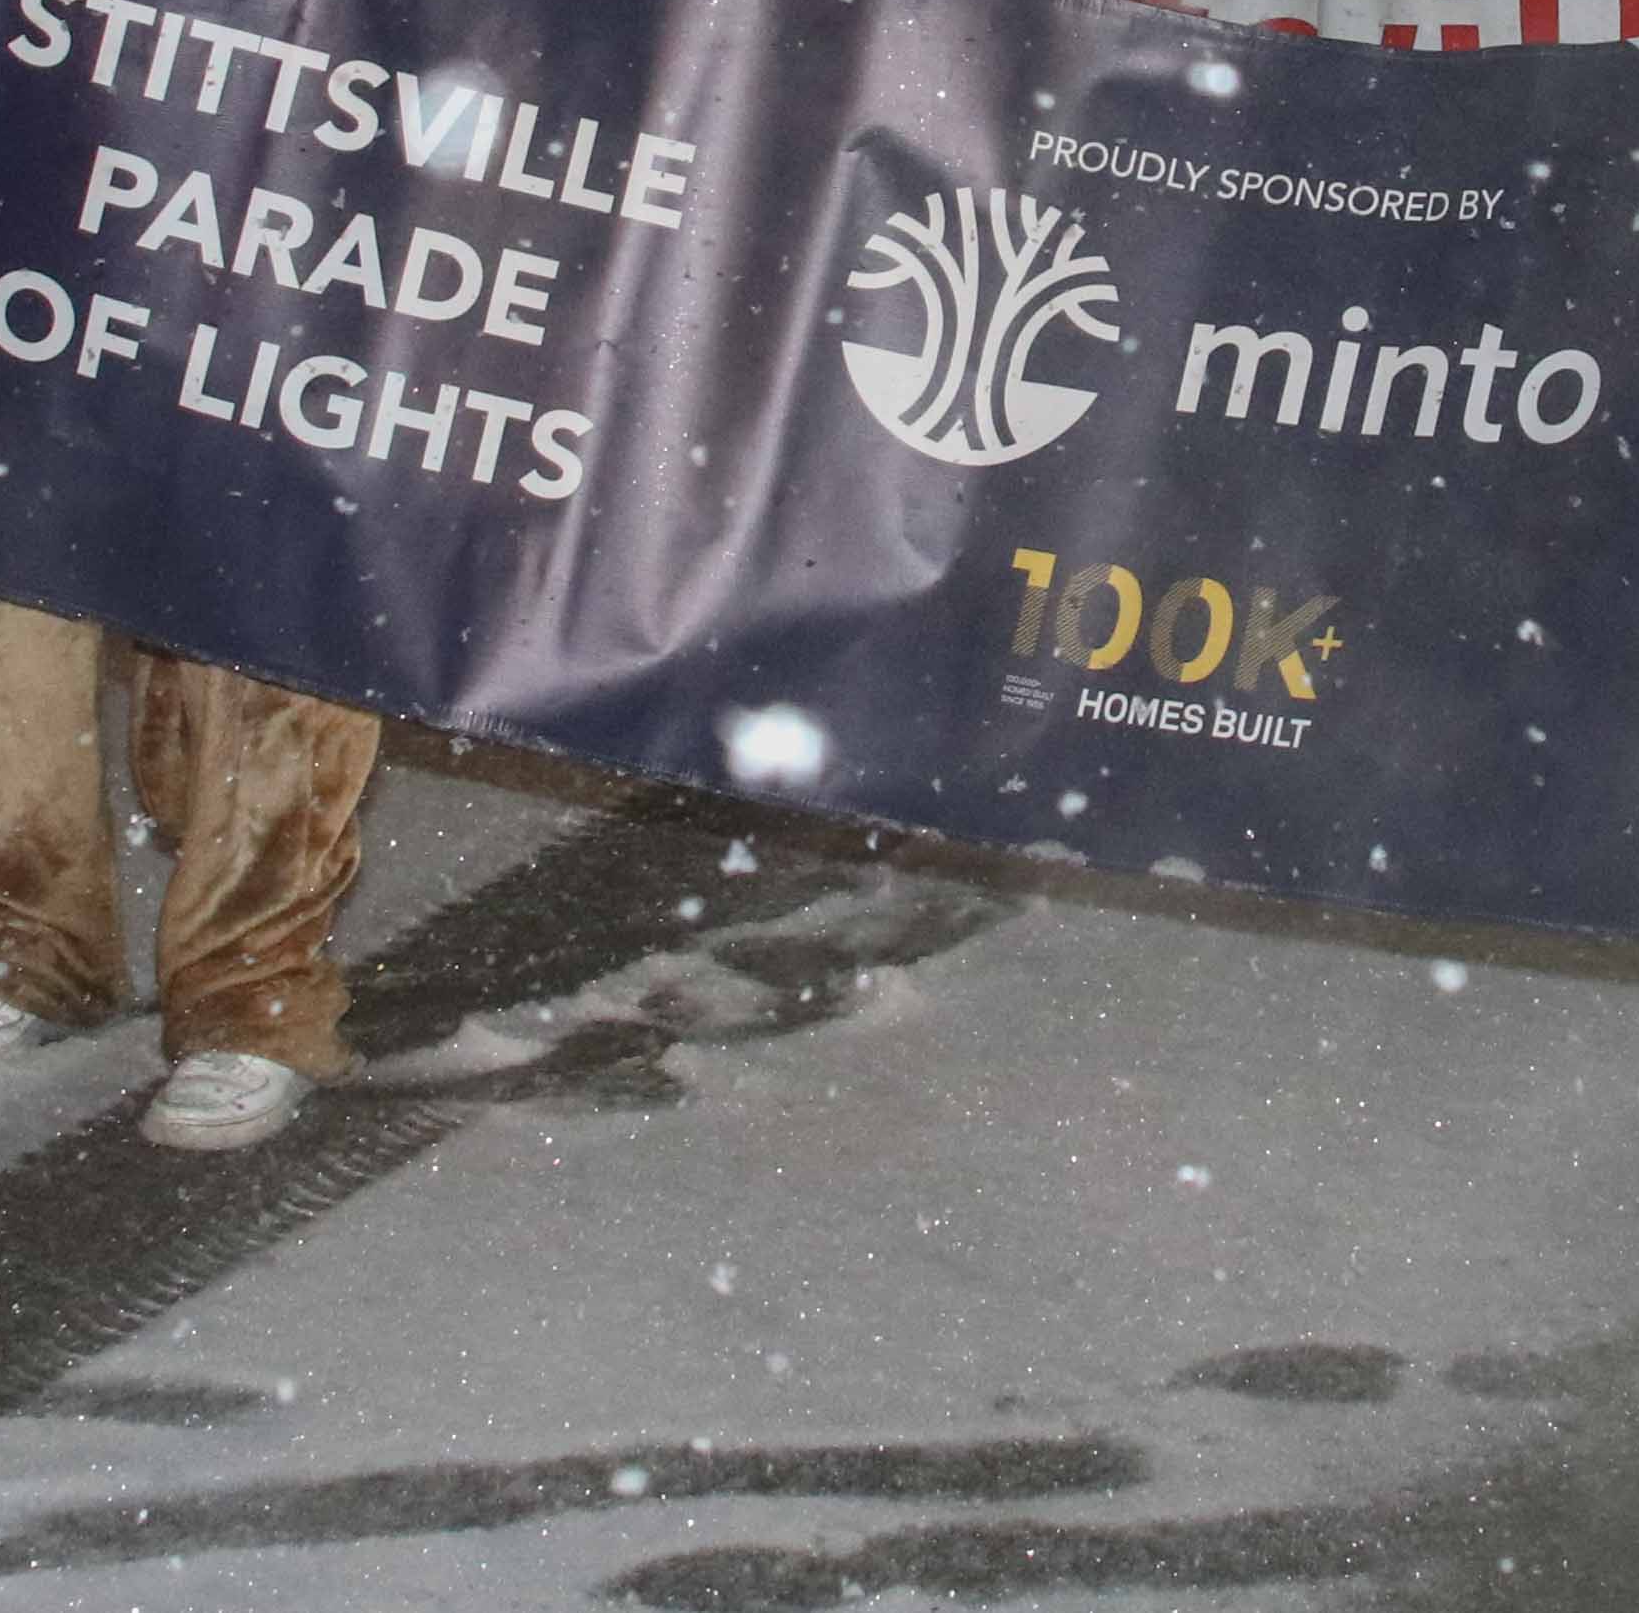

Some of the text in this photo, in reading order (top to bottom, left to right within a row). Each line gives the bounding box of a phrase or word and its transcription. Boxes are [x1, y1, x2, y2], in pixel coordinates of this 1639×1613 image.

[77, 144, 560, 346] PARADE
[1029, 130, 1505, 222] PROUDLY SPONSORED BY
[177, 333, 594, 500] LIGHTS
[1173, 306, 1603, 445] minto
[1076, 688, 1312, 748] HOMES BUILT
